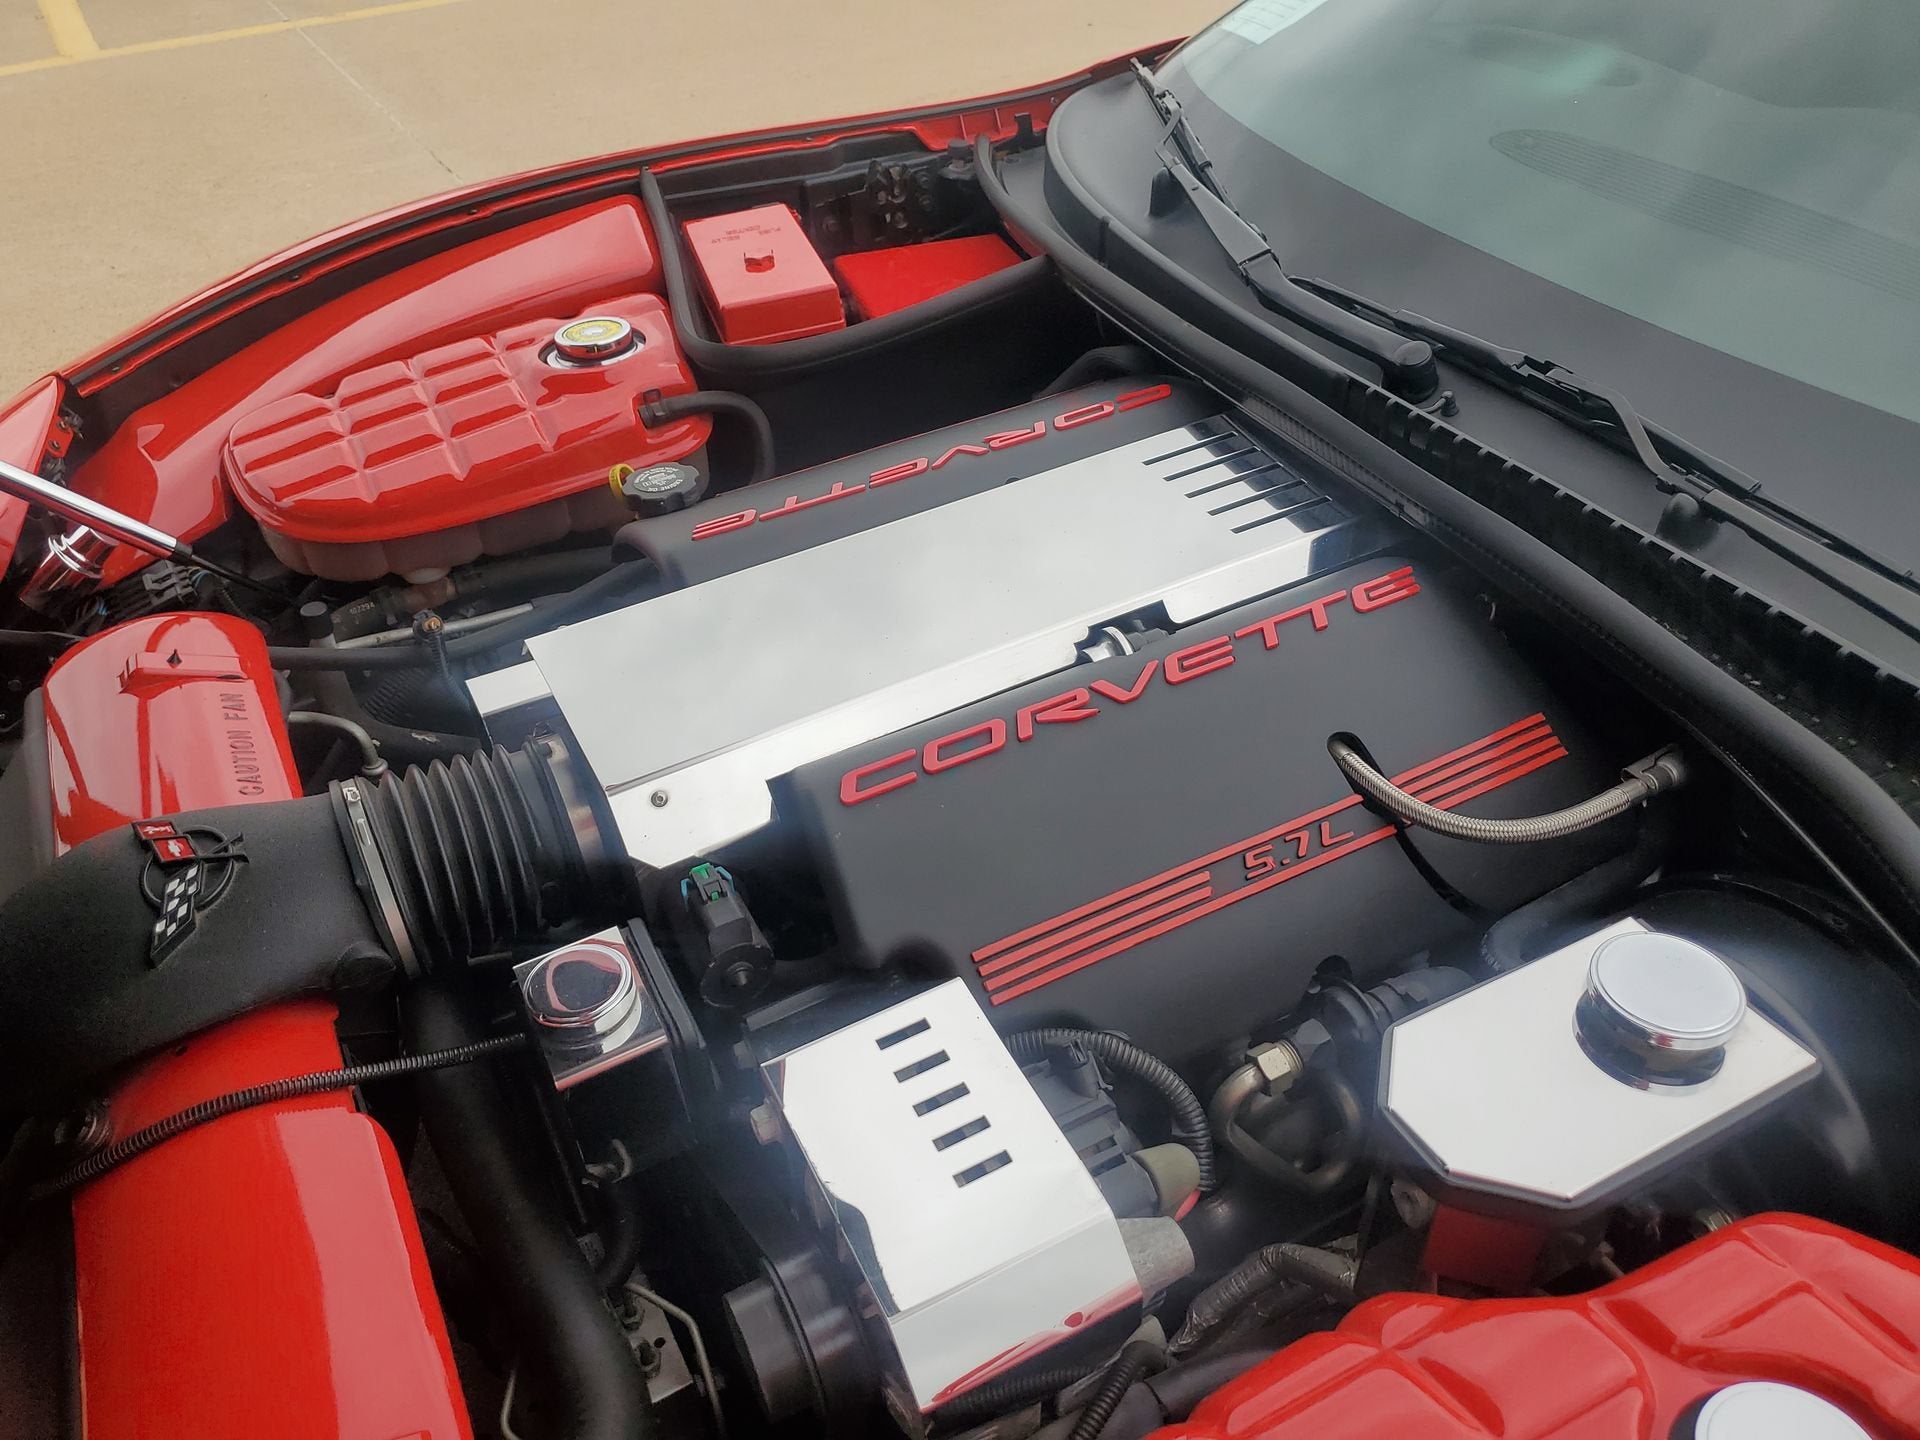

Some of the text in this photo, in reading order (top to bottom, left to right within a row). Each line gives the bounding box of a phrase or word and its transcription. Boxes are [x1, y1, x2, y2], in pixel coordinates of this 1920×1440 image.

[691, 383, 1172, 541] CORVETTE
[219, 693, 265, 796] CAUTION FAN
[839, 565, 1421, 805] CORVETTE
[1244, 821, 1354, 881] 5.7L
